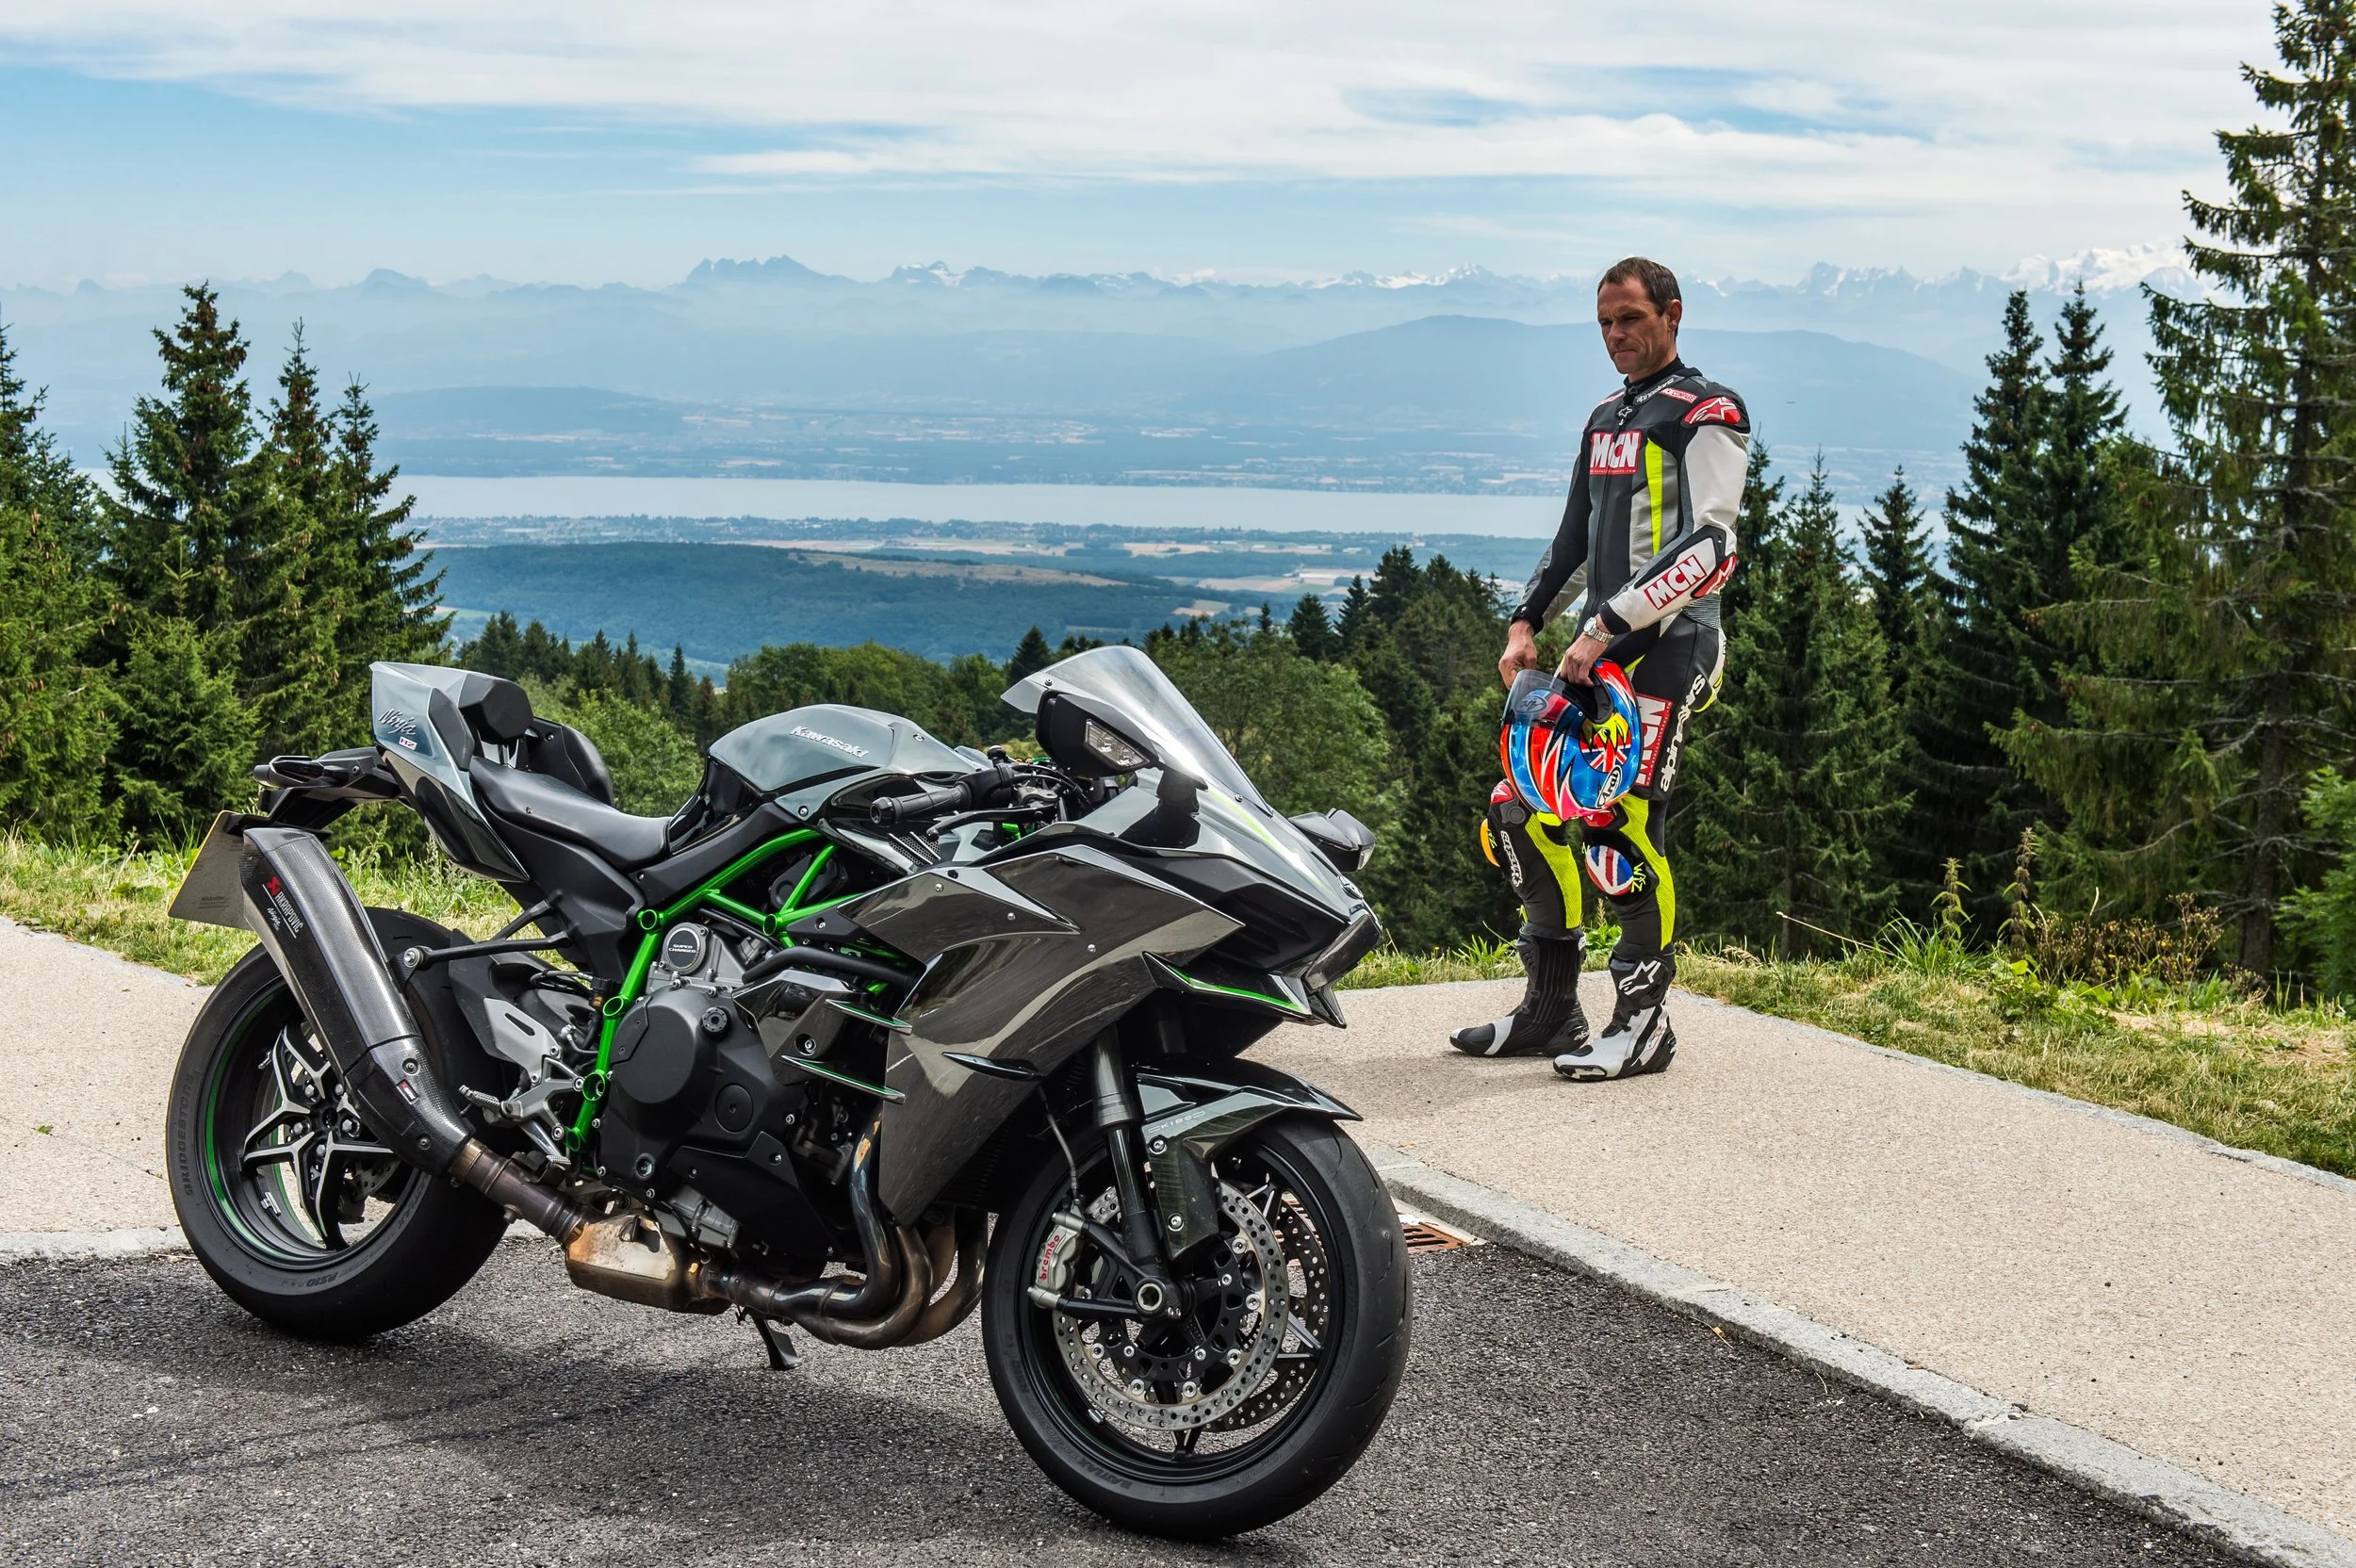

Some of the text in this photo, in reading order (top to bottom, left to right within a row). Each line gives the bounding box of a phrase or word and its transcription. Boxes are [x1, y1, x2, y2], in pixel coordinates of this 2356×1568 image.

[1589, 433, 1641, 468] MCN
[1646, 554, 1707, 609] MCN
[378, 709, 417, 735] Ninja
[400, 738, 415, 747] H2
[790, 725, 869, 759] Kawasaki
[1039, 1234, 1060, 1281] brembo
